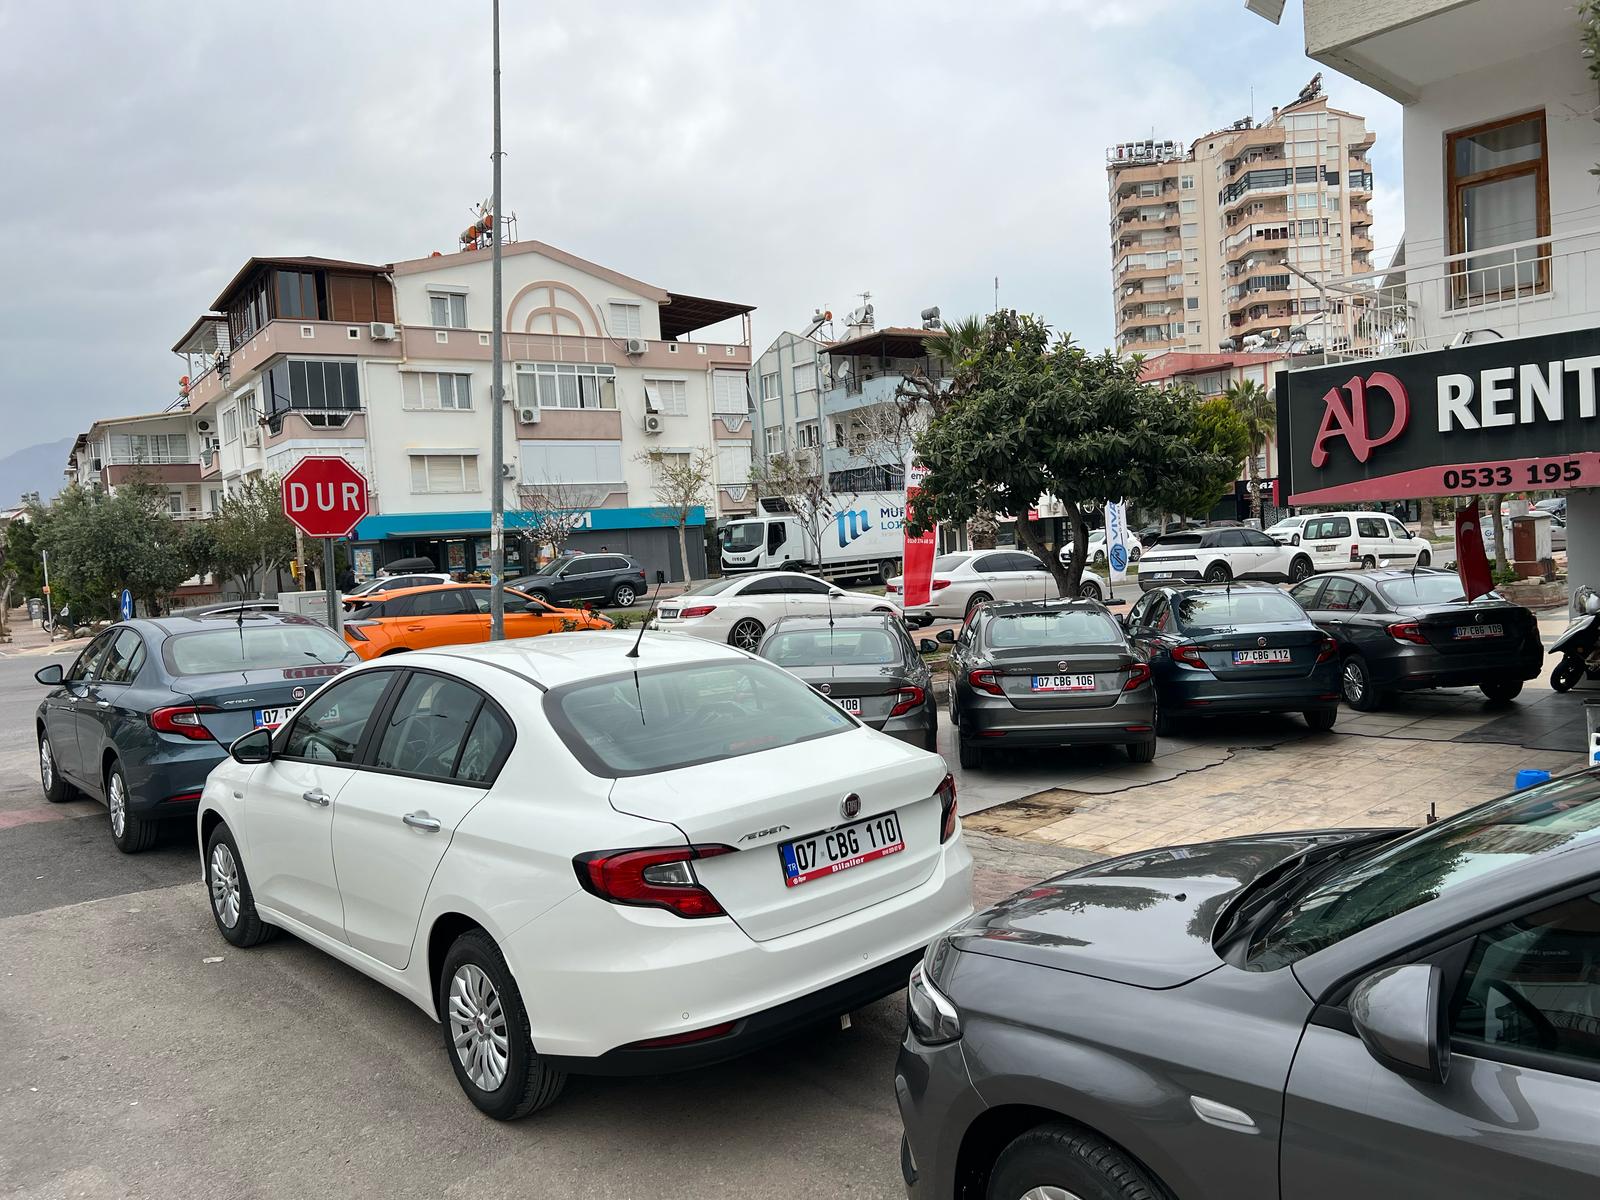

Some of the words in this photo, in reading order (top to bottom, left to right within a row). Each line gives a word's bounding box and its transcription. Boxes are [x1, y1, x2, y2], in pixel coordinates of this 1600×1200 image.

[1437, 355, 1600, 432] RENT
[1311, 372, 1410, 468] AD
[1443, 466, 1513, 489] 0533
[1526, 460, 1581, 485] 195
[290, 482, 361, 512] DUR
[1238, 651, 1249, 660] 07
[1252, 651, 1269, 660] CBG
[1273, 650, 1289, 659] 112
[1038, 677, 1050, 687] 07
[1053, 676, 1072, 686] CBG
[1075, 675, 1093, 686] 106
[840, 699, 858, 710] 108
[263, 710, 279, 724] 07
[795, 840, 817, 871] 07
[825, 828, 860, 861] CBG
[865, 818, 897, 848] 110
[787, 863, 797, 872] TR
